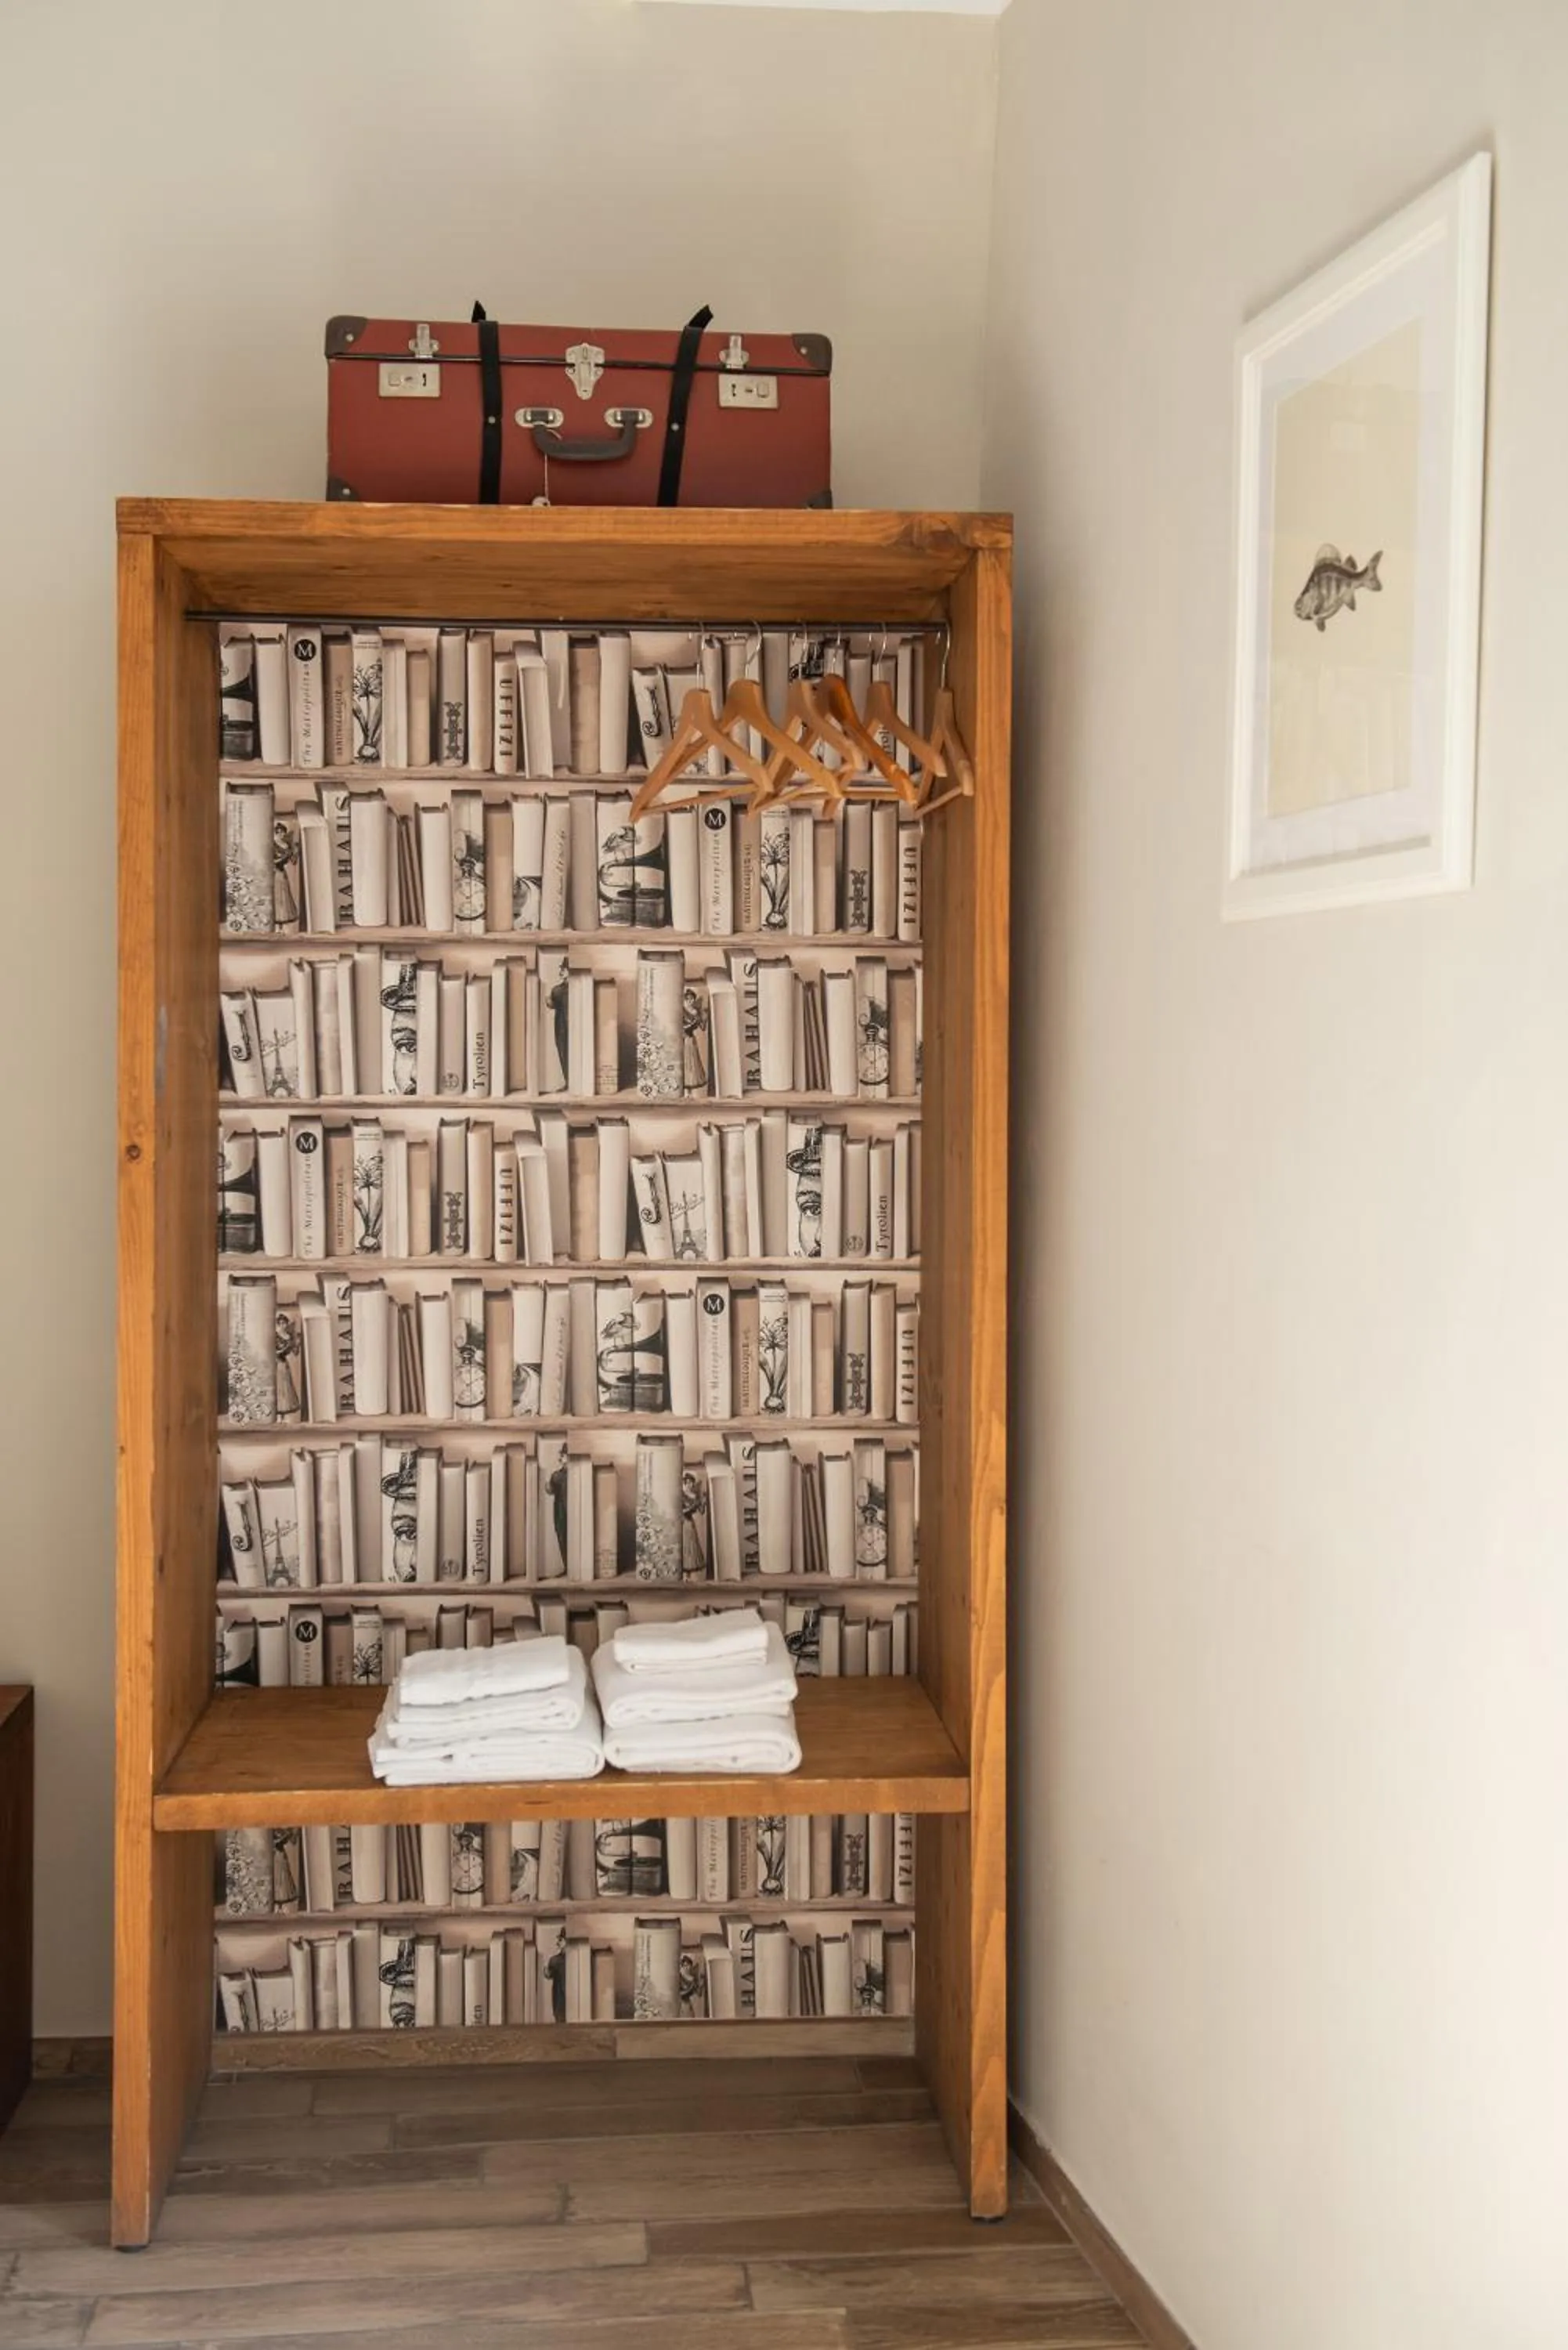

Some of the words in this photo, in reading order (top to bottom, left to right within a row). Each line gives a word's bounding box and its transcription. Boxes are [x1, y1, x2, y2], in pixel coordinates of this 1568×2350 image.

[297, 642, 313, 657] M
[499, 678, 514, 757] UFFIZI
[707, 811, 723, 826] M
[903, 846, 918, 924] UFFIZI
[471, 1032, 487, 1090] Tyrolien
[298, 1135, 315, 1151] M
[499, 1167, 514, 1246] UFFIZI
[875, 1195, 891, 1253] Tyrolien
[706, 1296, 721, 1311] M
[901, 1329, 916, 1406] UFFIZI
[471, 1518, 488, 1577] Tyrolien
[298, 1623, 314, 1640] M
